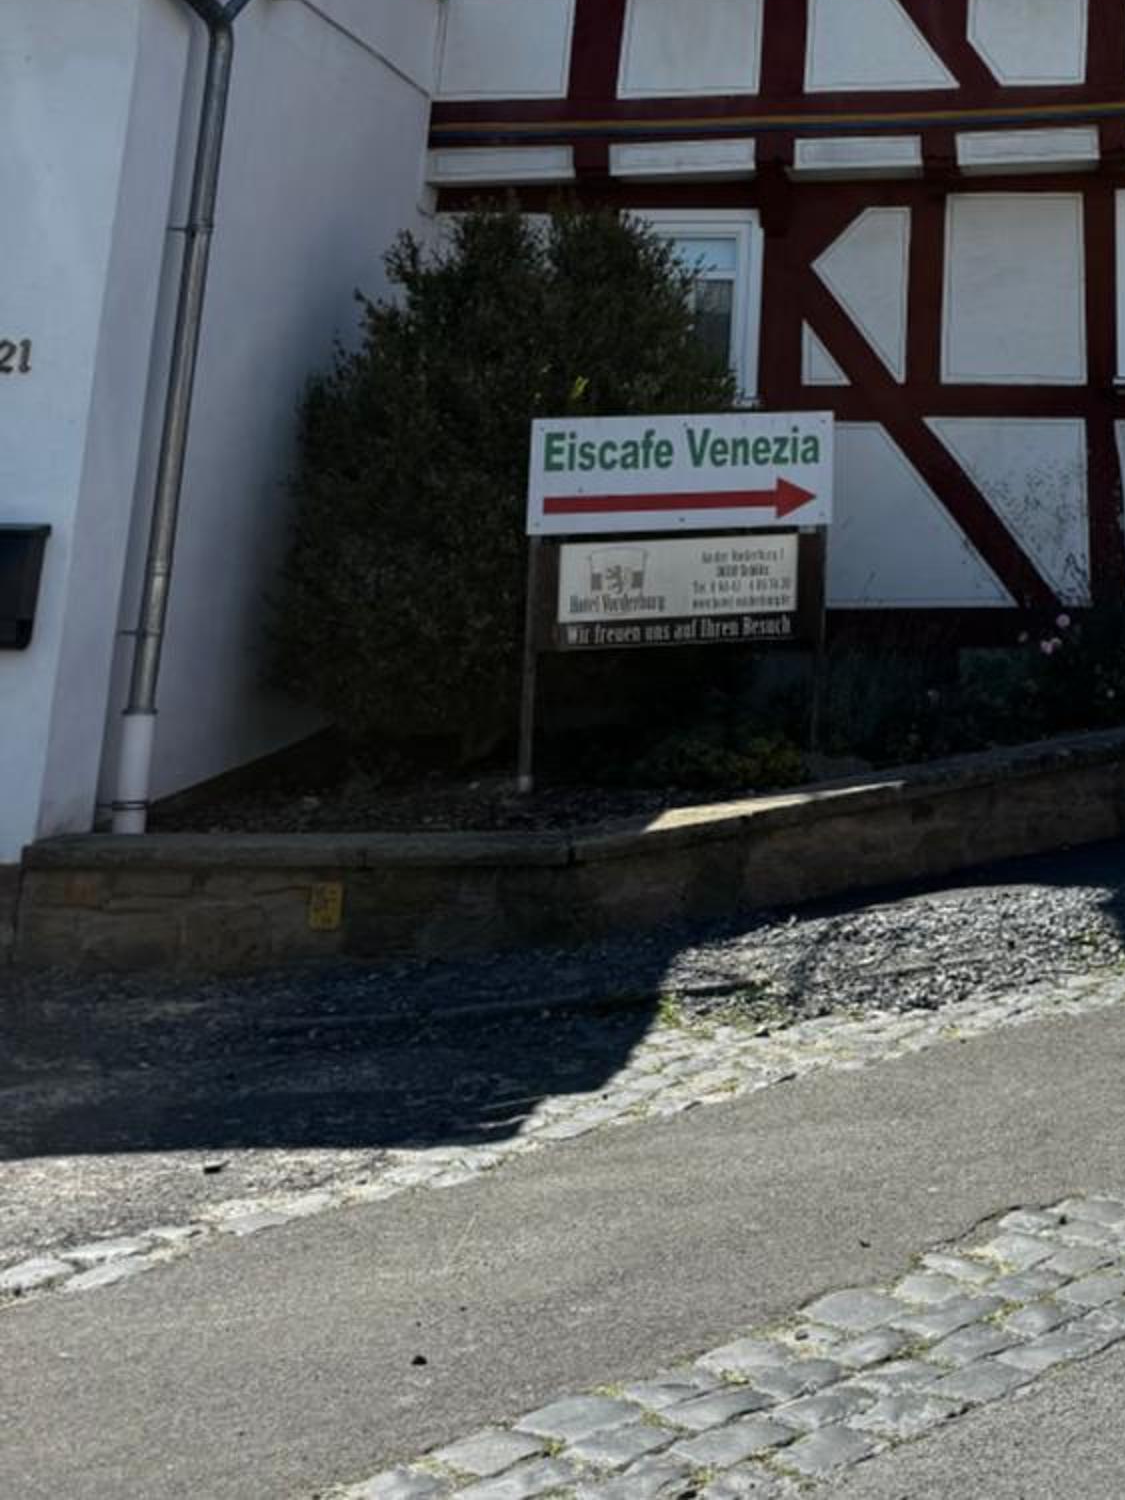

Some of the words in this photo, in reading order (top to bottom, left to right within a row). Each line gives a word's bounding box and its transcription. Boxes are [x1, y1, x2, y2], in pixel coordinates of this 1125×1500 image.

[0, 338, 32, 374] 21
[543, 429, 674, 472] Eiscafe
[686, 426, 820, 468] Venezia
[567, 626, 590, 644] Wir
[595, 623, 641, 643] freuen
[645, 625, 670, 641] uns
[673, 619, 697, 640] auf
[700, 617, 738, 638] Ihren
[743, 614, 791, 635] Besuch
